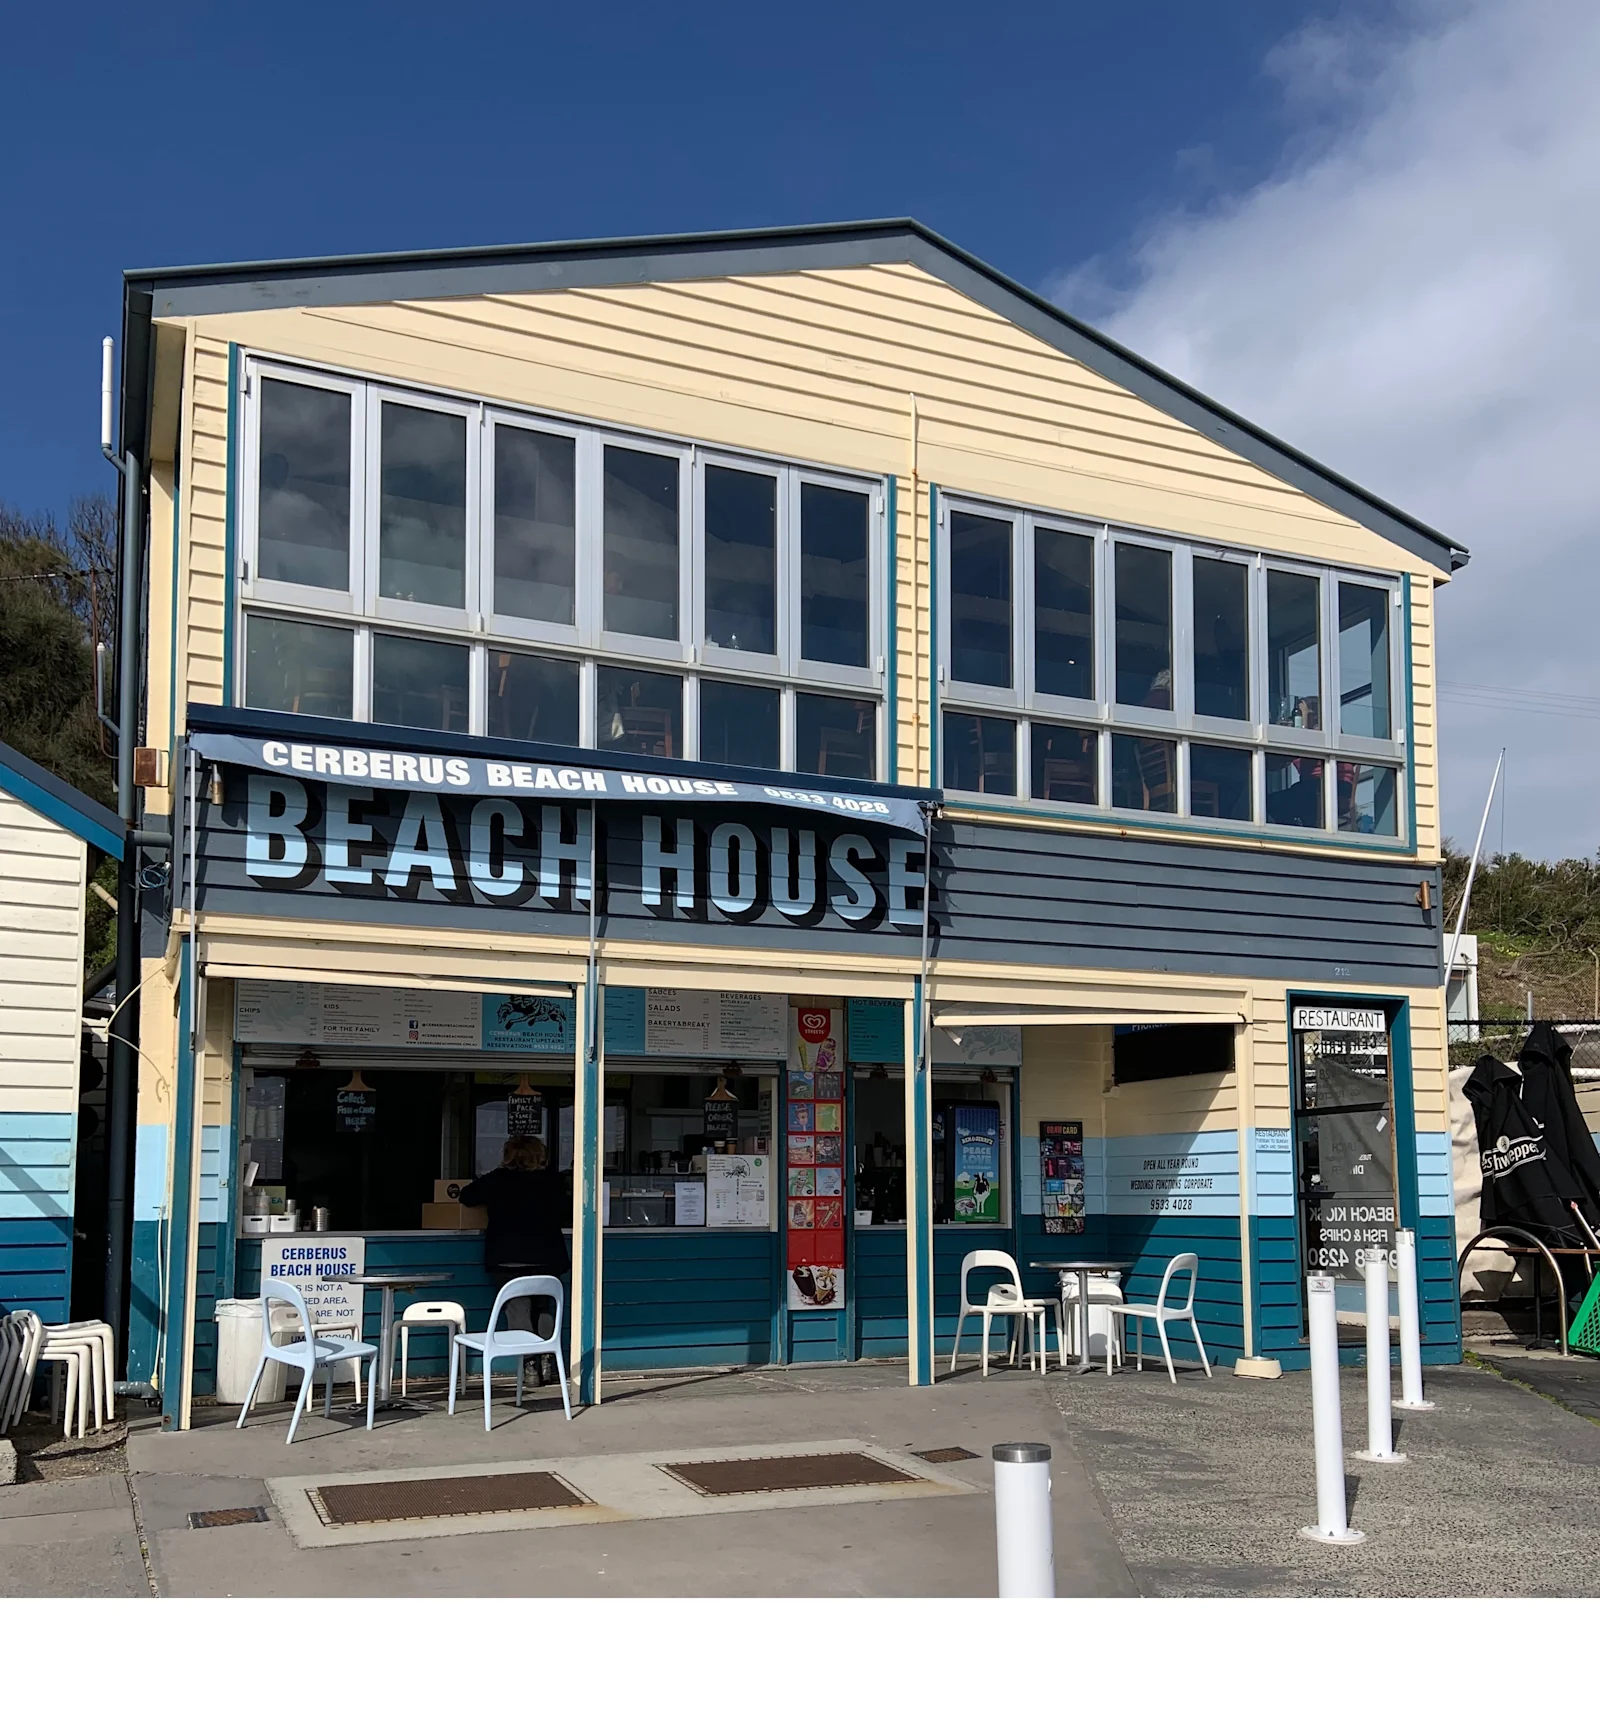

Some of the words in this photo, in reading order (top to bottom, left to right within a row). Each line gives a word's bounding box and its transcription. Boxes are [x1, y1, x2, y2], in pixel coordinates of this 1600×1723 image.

[262, 740, 471, 786] CERBERUS
[486, 763, 608, 792] BEACH
[621, 774, 739, 796] HOUSE
[763, 786, 827, 806] 9533
[832, 795, 890, 814] 4028
[245, 773, 592, 900] BEACH
[641, 813, 929, 925] HOUSE
[1334, 967, 1350, 976] 212
[648, 988, 677, 996] SAUCES
[720, 993, 762, 1001] BEVERAGES
[648, 1004, 681, 1012] SALADS
[648, 1019, 711, 1028] BAKERY&BREAKY
[1299, 1009, 1383, 1029] RESTAURANT
[508, 1096, 531, 1104] FAMILY
[962, 1146, 992, 1154] PEACE
[962, 1154, 992, 1164] LOVE
[1143, 1160, 1156, 1170] OPEN
[1156, 1159, 1166, 1170] ALL
[1167, 1158, 1180, 1169] YEAR
[1180, 1158, 1199, 1168] ROUND
[1130, 1180, 1154, 1190] WEDDINGS
[1156, 1179, 1181, 1190] FUNCTIONS
[1184, 1178, 1213, 1190] CORPORATE
[1150, 1199, 1170, 1210] 9533
[1172, 1199, 1192, 1210] 4028
[282, 1248, 347, 1260] CERBERUS
[271, 1264, 312, 1276] BEACH
[316, 1263, 356, 1276] HOUSE
